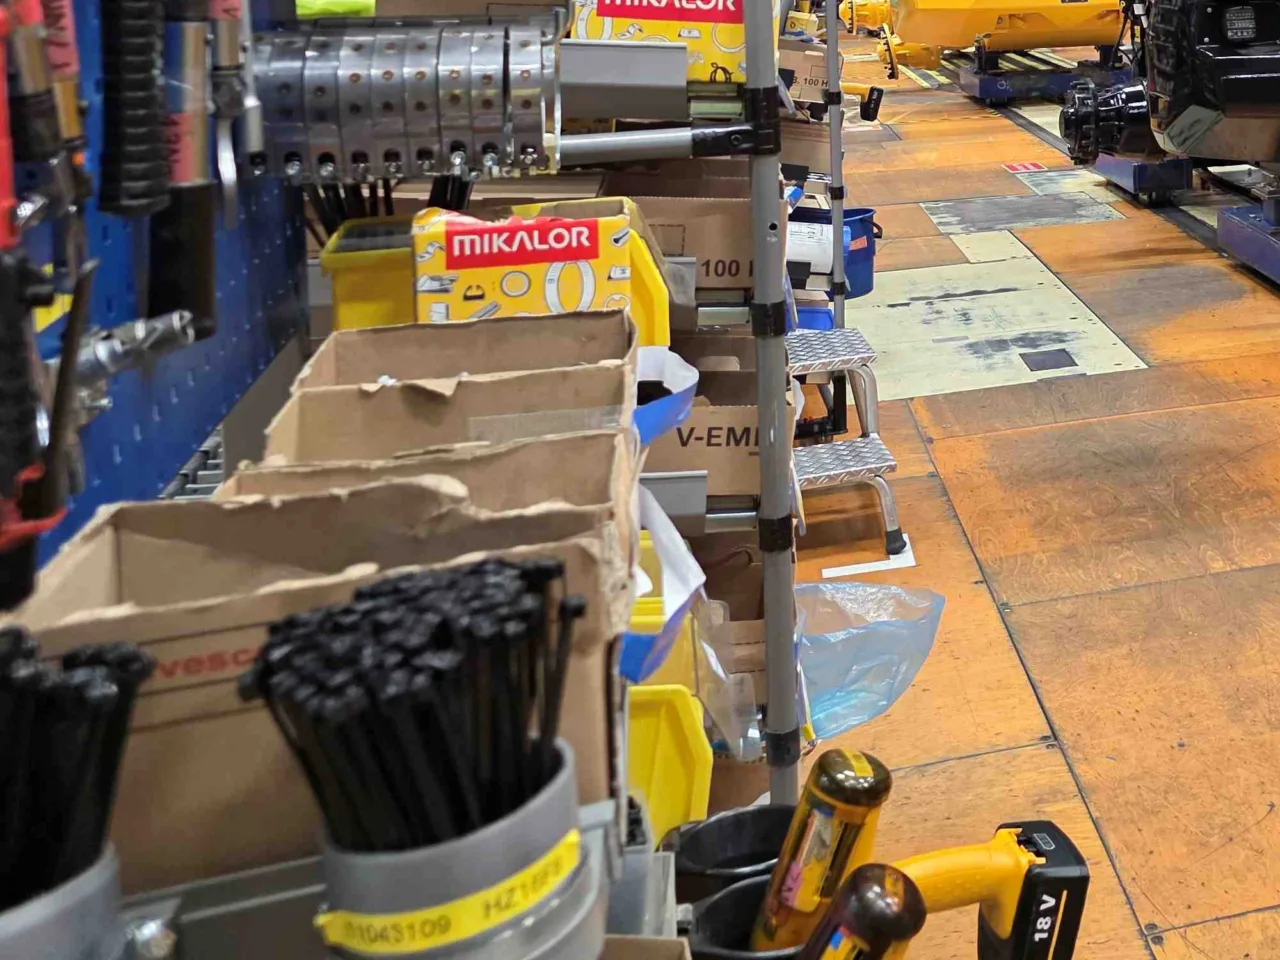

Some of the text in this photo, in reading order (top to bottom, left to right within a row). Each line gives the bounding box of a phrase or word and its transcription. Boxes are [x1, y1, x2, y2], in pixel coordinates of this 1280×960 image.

[803, 77, 819, 86] 100
[452, 226, 591, 257] MIKALOR
[701, 258, 740, 278] 100
[676, 426, 760, 448] V-EM
[1034, 893, 1056, 942] 18 V
